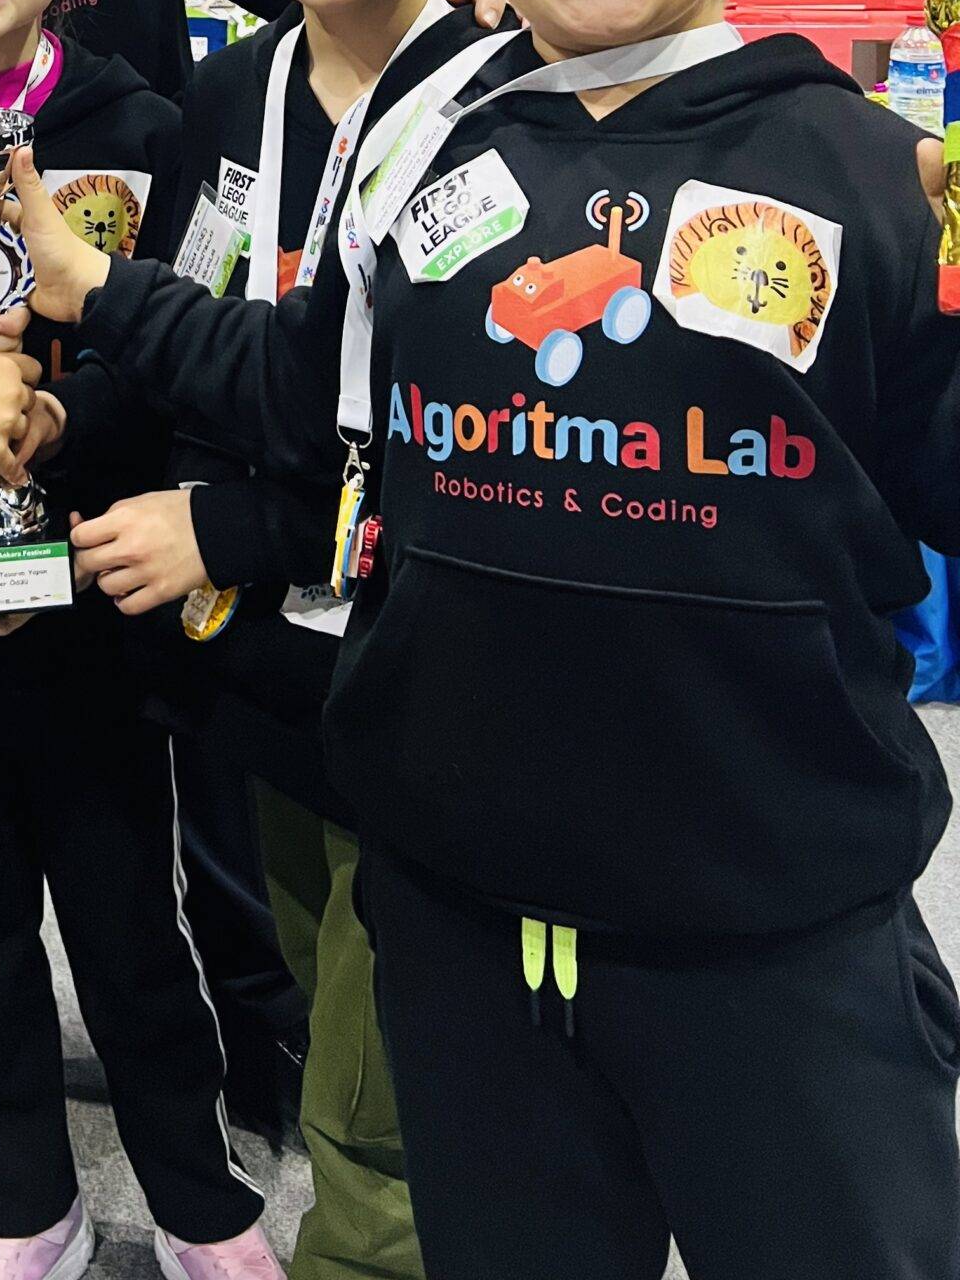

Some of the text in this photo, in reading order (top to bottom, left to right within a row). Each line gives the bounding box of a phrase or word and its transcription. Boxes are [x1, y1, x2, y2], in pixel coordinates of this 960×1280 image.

[224, 167, 256, 191] FIRST
[222, 184, 246, 206] LEGO
[219, 200, 249, 226] EAGUE
[387, 382, 816, 479] Algoritma Lab
[434, 471, 718, 529] Robotics & Coding
